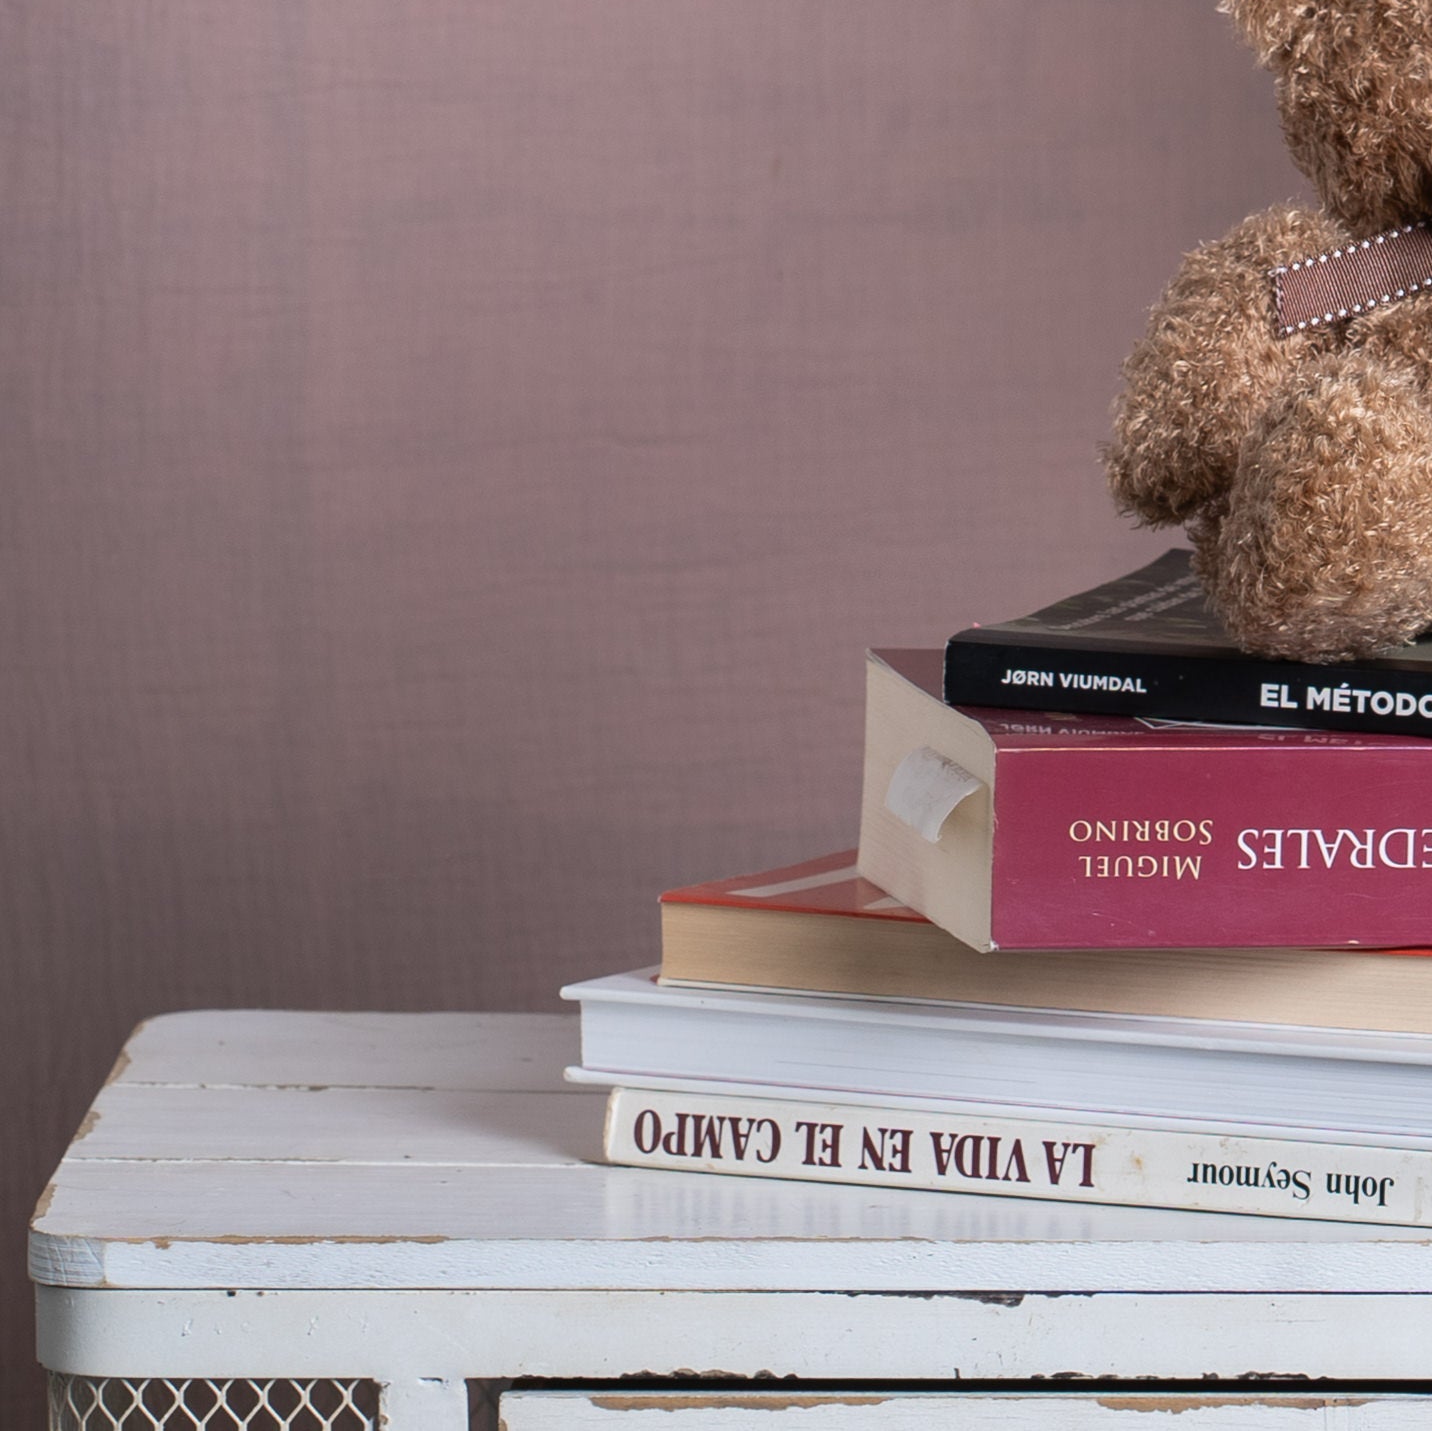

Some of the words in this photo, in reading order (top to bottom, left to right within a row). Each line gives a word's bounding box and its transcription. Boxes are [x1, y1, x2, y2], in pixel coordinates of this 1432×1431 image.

[1001, 669, 1054, 687] JØRN
[1059, 672, 1147, 693] VIUMDAL
[1260, 683, 1298, 709] EL
[1069, 819, 1213, 845] SOBRINO
[1078, 855, 1202, 880] MIGUEL
[633, 1109, 782, 1164] CAMPO
[794, 1121, 844, 1168] EL
[857, 1126, 914, 1174] EN
[929, 1131, 1031, 1183] VIDA
[1041, 1140, 1097, 1188] LA
[1186, 1161, 1312, 1200] Seymour
[1326, 1173, 1395, 1207] John
